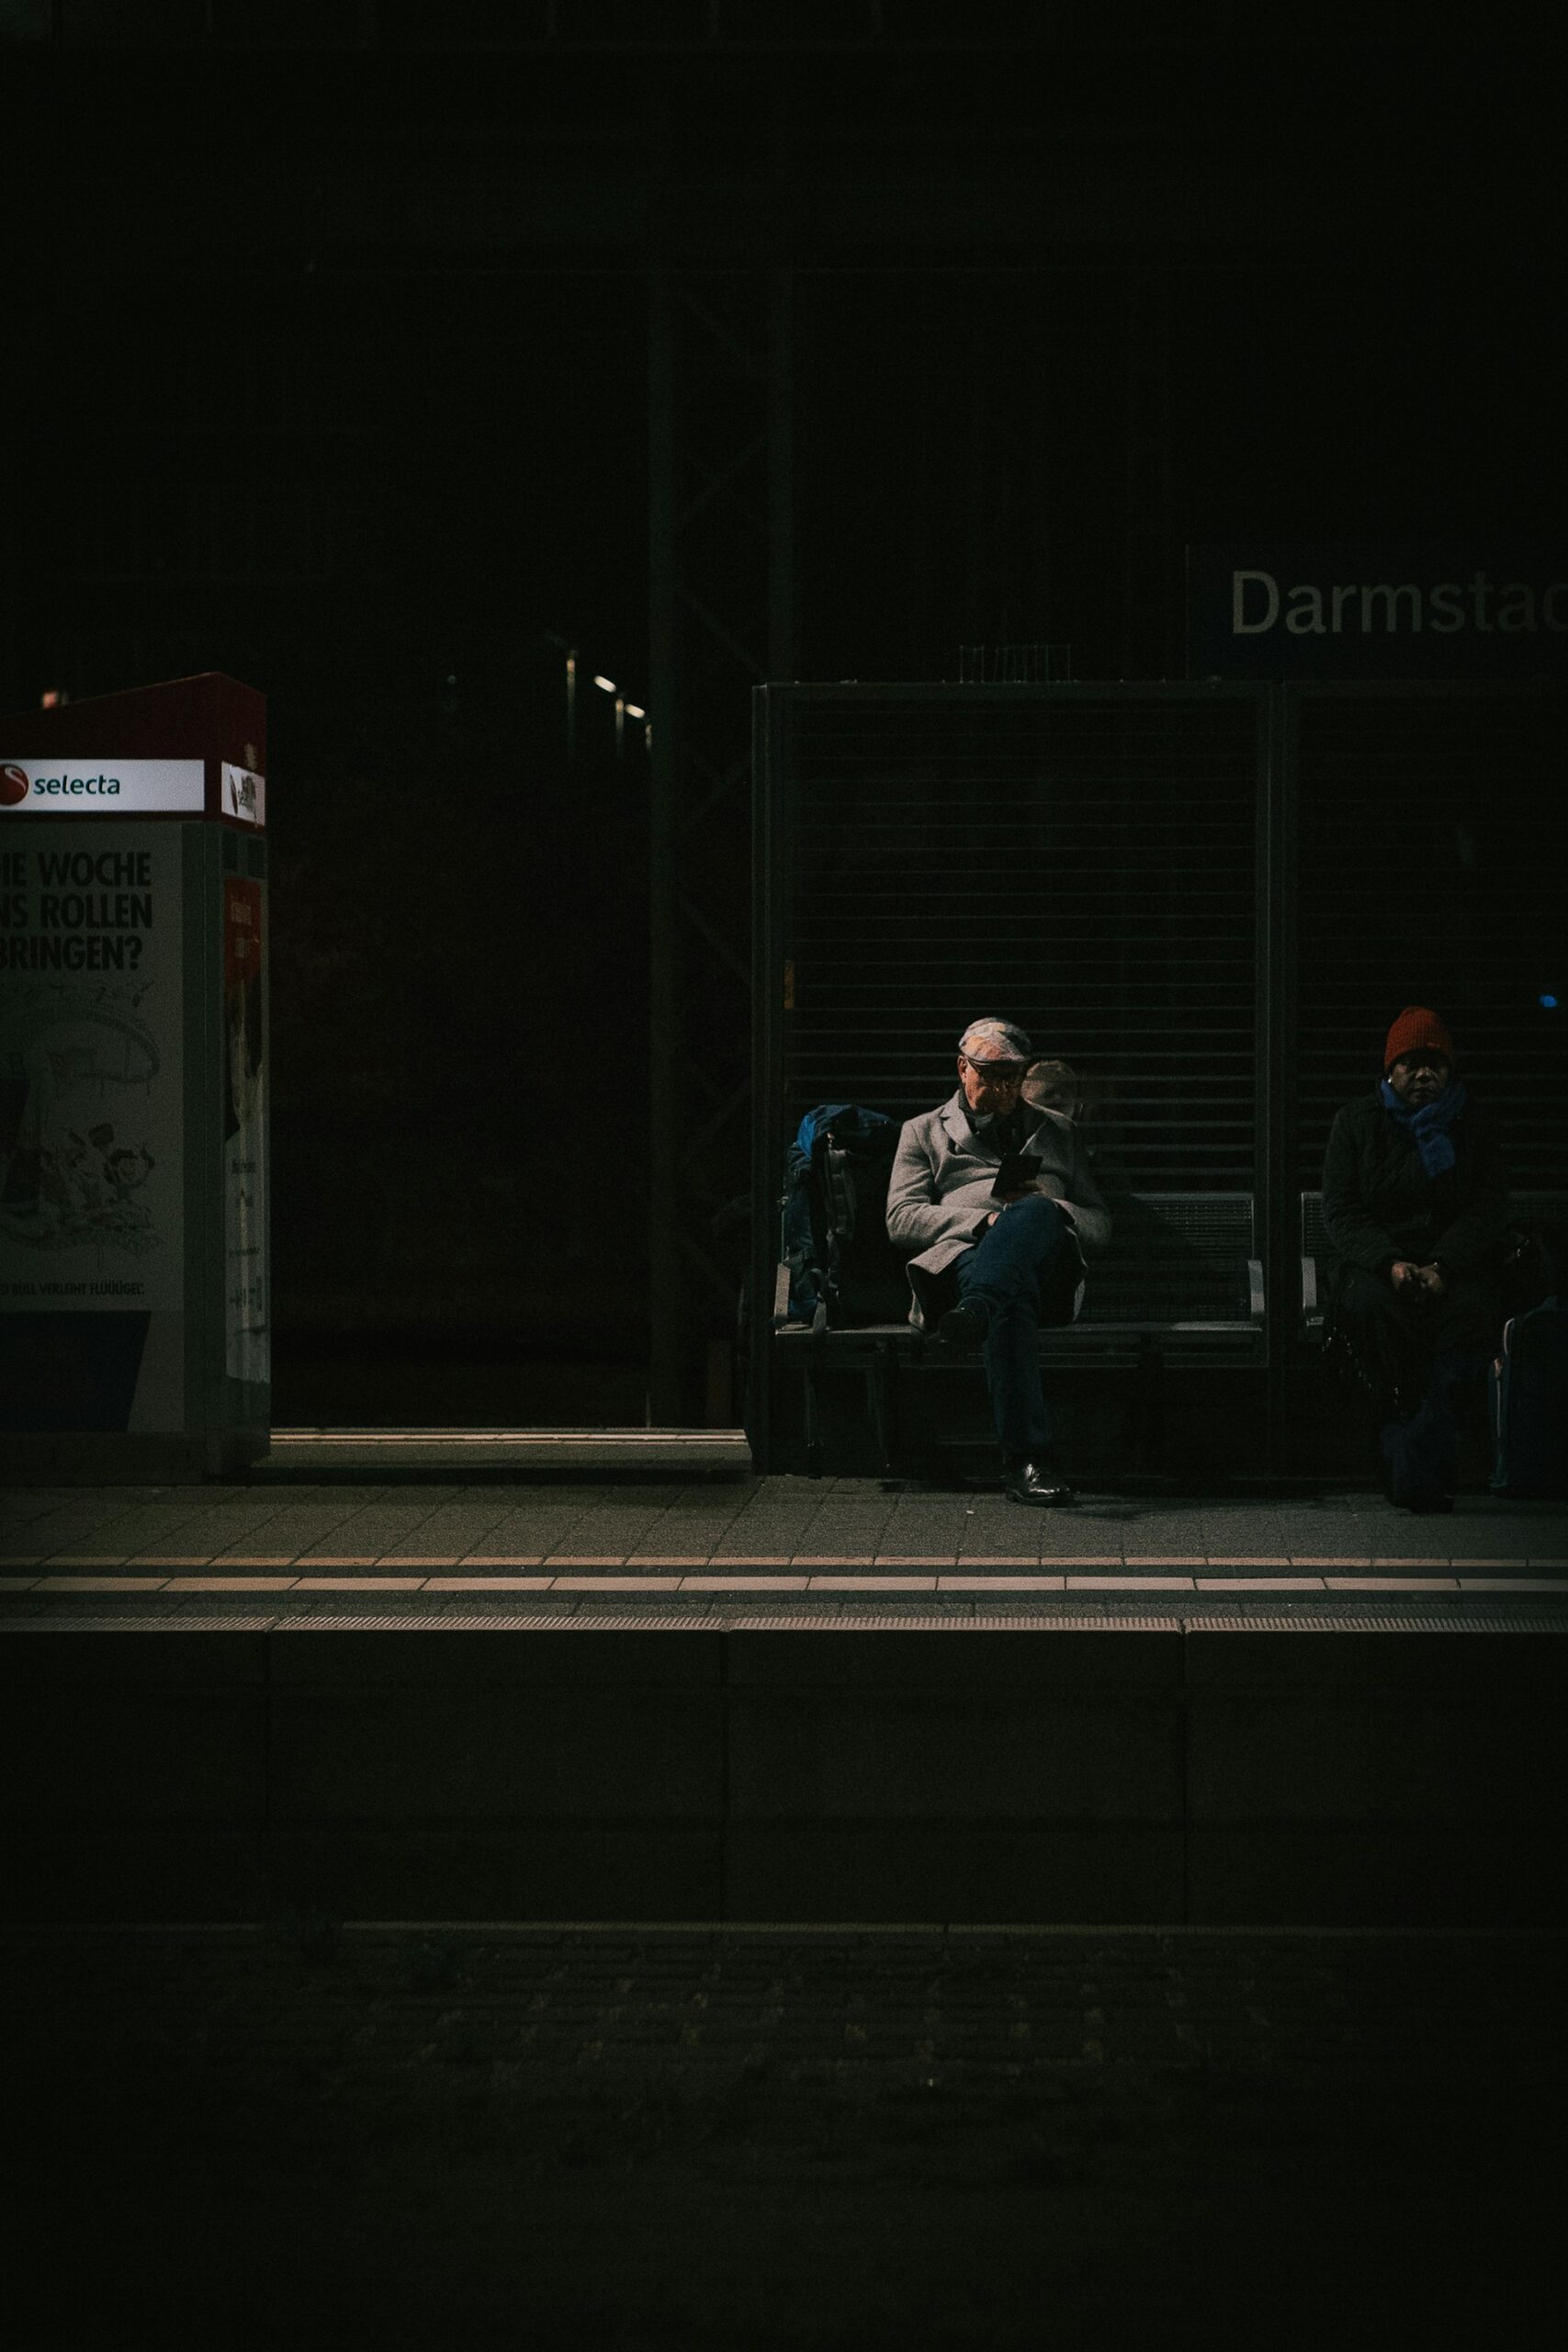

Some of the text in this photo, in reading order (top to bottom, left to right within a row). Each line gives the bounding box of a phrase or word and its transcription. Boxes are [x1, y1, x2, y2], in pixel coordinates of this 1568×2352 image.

[33, 775, 120, 795] selecta
[38, 852, 152, 887] WOCHE
[40, 893, 152, 928] ROLLEN
